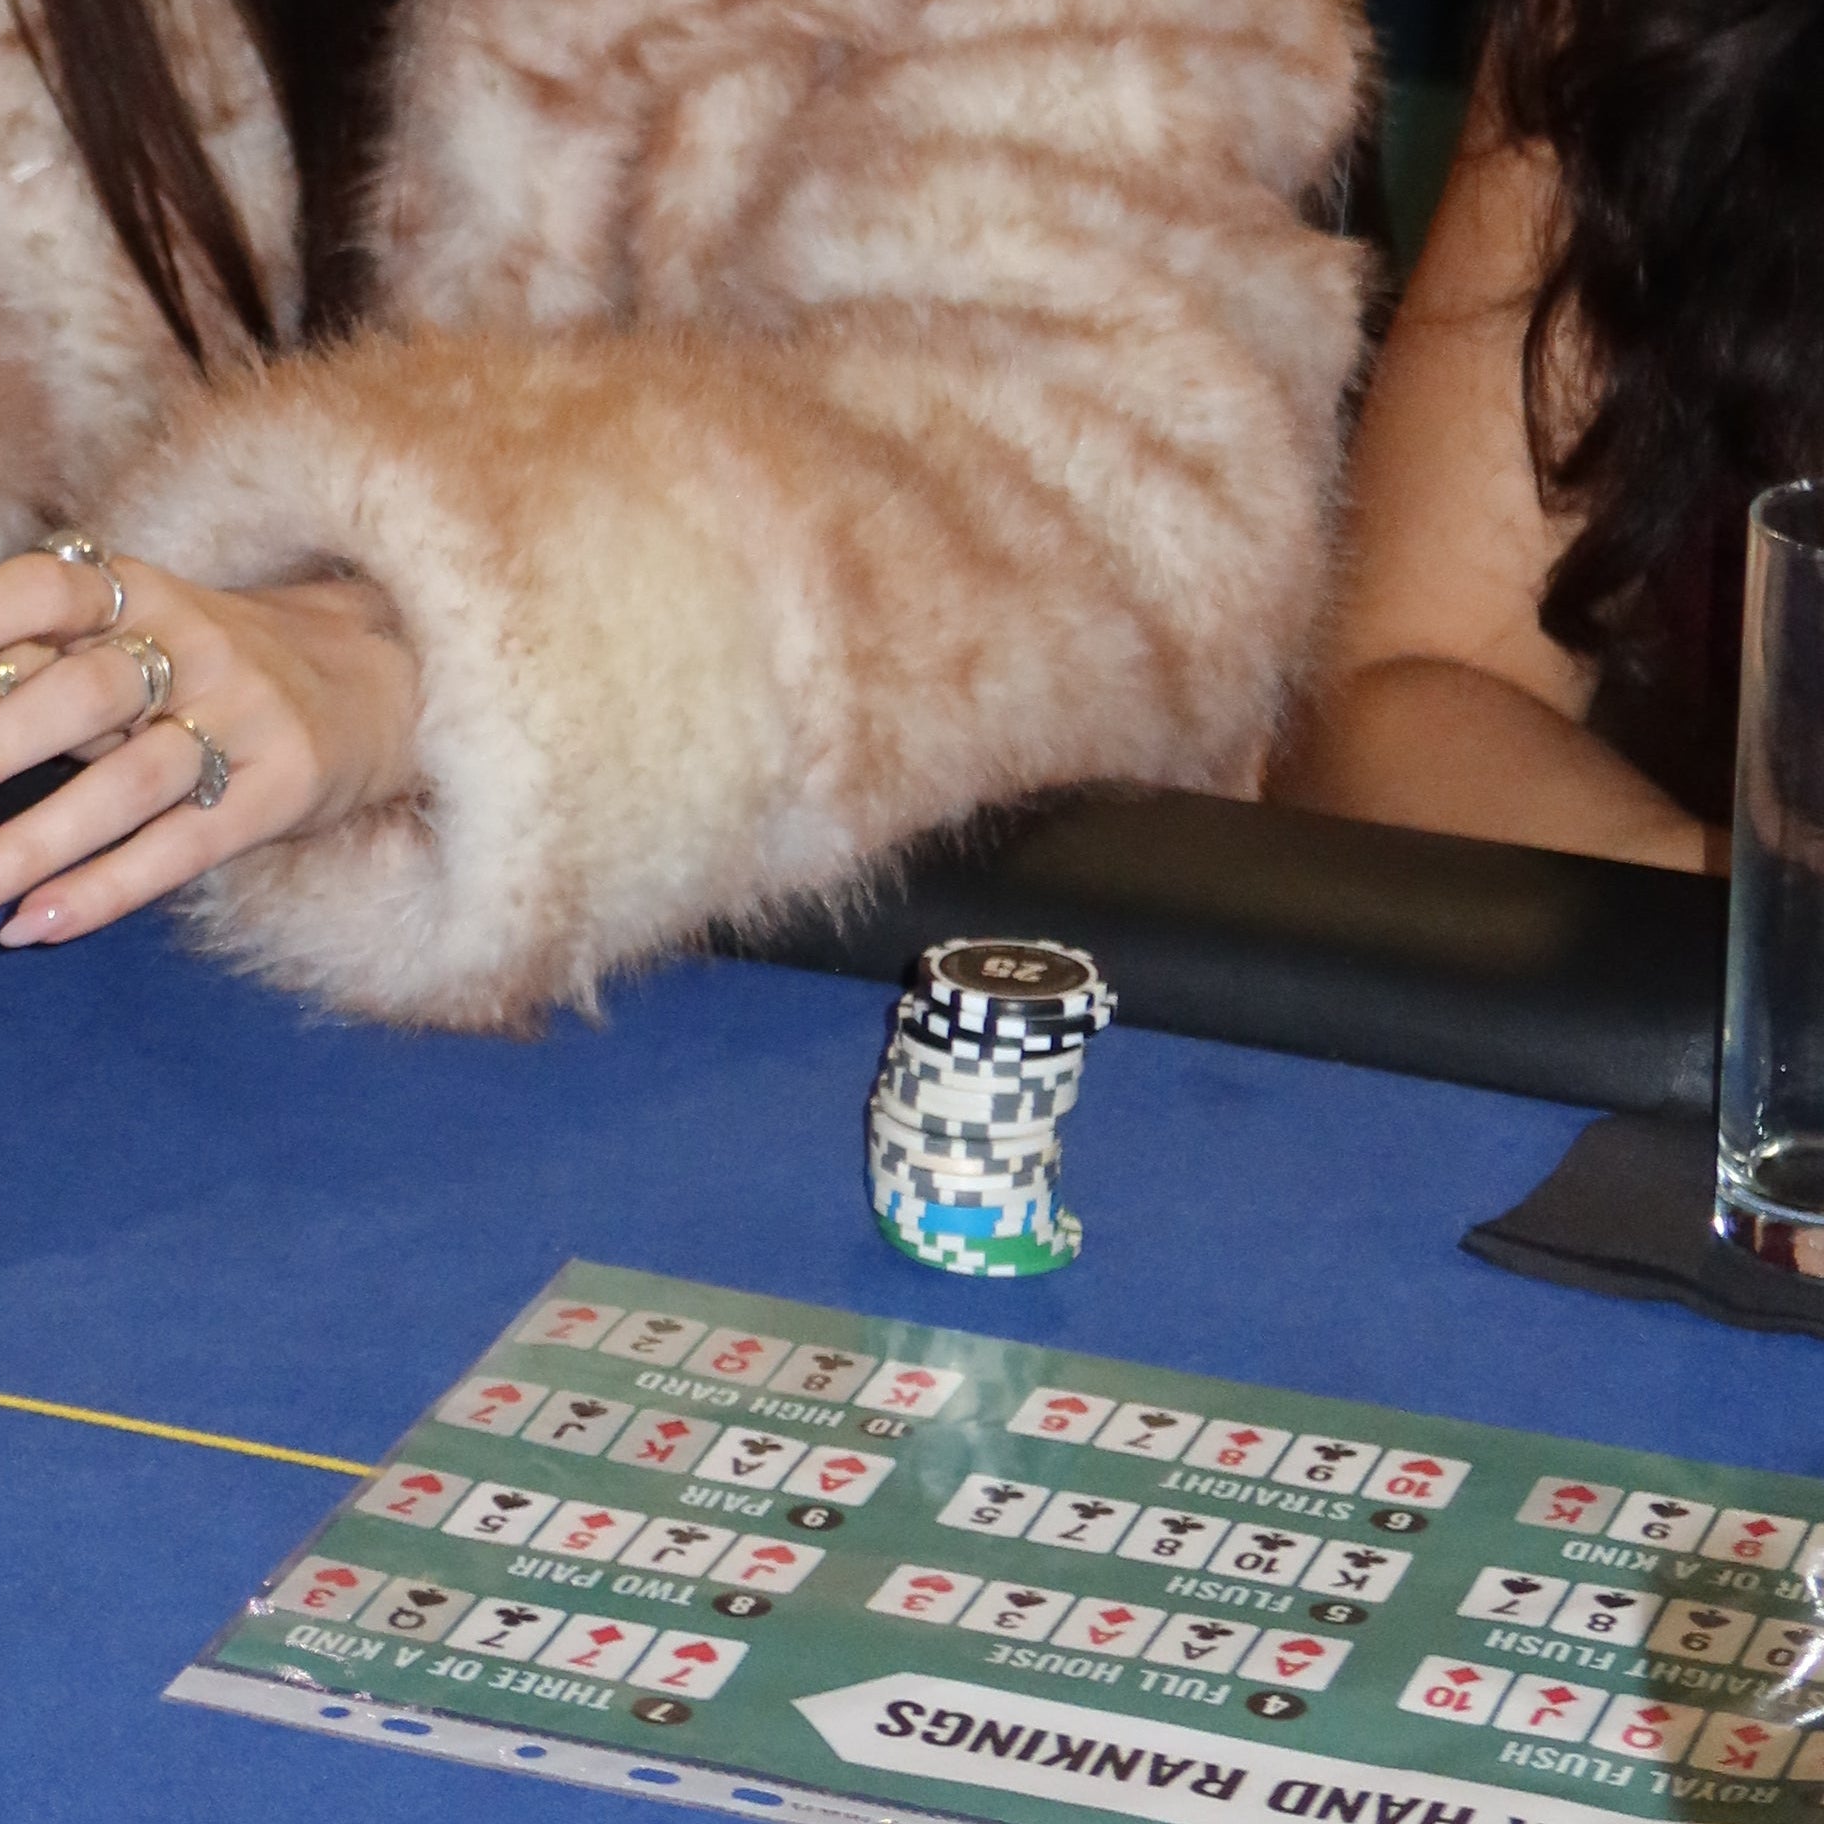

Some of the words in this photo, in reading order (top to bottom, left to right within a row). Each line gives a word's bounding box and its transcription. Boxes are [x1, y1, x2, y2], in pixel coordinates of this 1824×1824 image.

[981, 956, 1048, 983] 25
[630, 1336, 662, 1353] 2
[712, 1353, 747, 1373] Q
[635, 1370, 742, 1405] CARD
[801, 1373, 831, 1392] 8
[883, 1388, 920, 1409] K
[469, 1405, 497, 1425] 7
[749, 1398, 846, 1428] HIGH
[553, 1422, 587, 1440] J
[865, 1419, 907, 1437] 10
[637, 1439, 675, 1462] K
[1125, 1433, 1154, 1449] 7
[730, 1456, 764, 1476] A
[1217, 1449, 1248, 1466] 8
[818, 1472, 852, 1493] A
[1305, 1464, 1337, 1482] 9
[1157, 1470, 1356, 1521] STRAIGHT
[1386, 1477, 1433, 1498] 10
[387, 1496, 418, 1515] 7
[680, 1484, 774, 1517] PAIR
[475, 1514, 510, 1534] 5
[801, 1508, 829, 1528] 9
[970, 1506, 1003, 1526] 5
[1384, 1512, 1413, 1530] 6
[1545, 1503, 1583, 1524] K
[561, 1531, 596, 1551] 5
[1057, 1524, 1087, 1542] 7
[1642, 1522, 1672, 1540] 9
[651, 1545, 685, 1563] J
[1152, 1537, 1183, 1557] 8
[1561, 1539, 1660, 1572] KIND
[506, 1555, 604, 1588] PAIR
[741, 1564, 776, 1581] J
[1235, 1552, 1283, 1575] 10
[1675, 1560, 1703, 1580] A
[1329, 1569, 1370, 1592] K
[1715, 1569, 1761, 1590] OF
[302, 1588, 336, 1608] 3
[611, 1579, 698, 1607] TWO
[901, 1593, 936, 1612] 3
[1165, 1576, 1295, 1614] FLUSH
[727, 1594, 755, 1616] 8
[1324, 1605, 1354, 1623] 5
[1489, 1599, 1520, 1616] 7
[389, 1607, 426, 1630] Q
[993, 1610, 1027, 1629] 3
[1586, 1612, 1617, 1632] 8
[284, 1624, 387, 1663] KIND
[480, 1629, 510, 1649] 7
[1088, 1625, 1124, 1645] A
[1680, 1632, 1713, 1652] 9
[392, 1646, 424, 1668] A
[568, 1648, 601, 1668] 7
[1181, 1640, 1218, 1660] A
[1484, 1628, 1617, 1672] FLUSH
[428, 1657, 483, 1682] OF
[984, 1643, 1125, 1686] HOUSE
[1274, 1657, 1311, 1677] A
[660, 1666, 693, 1687] 7
[488, 1666, 617, 1711] THREE
[1140, 1669, 1234, 1706] FULL
[1260, 1694, 1290, 1717] 4
[1424, 1686, 1472, 1712] 10
[646, 1702, 674, 1723] 7
[1530, 1707, 1564, 1726] J
[1623, 1725, 1665, 1751] Q
[876, 1699, 1249, 1802] RANKINGS
[1718, 1744, 1758, 1770] K
[1500, 1740, 1635, 1787] FLUSH
[1651, 1770, 1781, 1803] ROYAL
[1267, 1777, 1478, 1824] HAND
